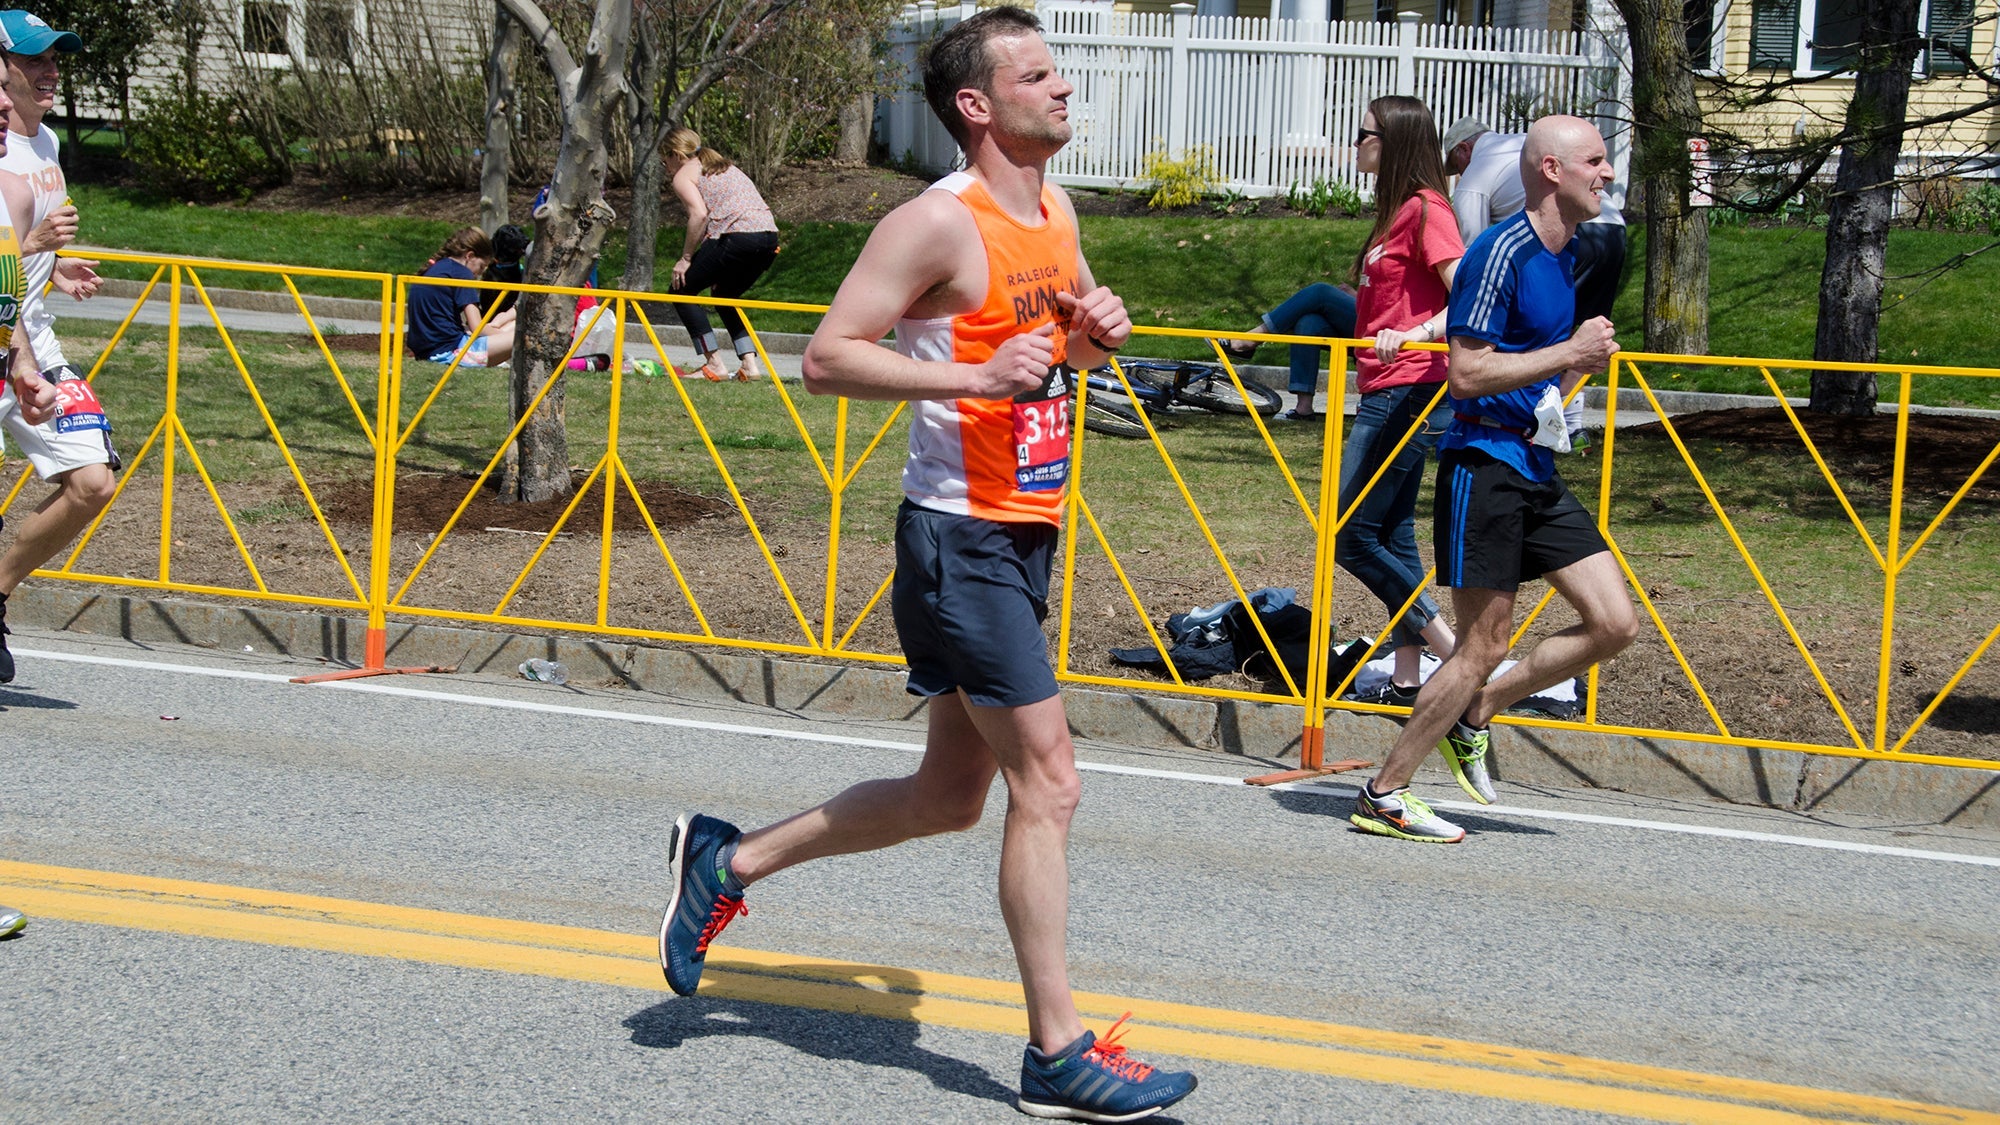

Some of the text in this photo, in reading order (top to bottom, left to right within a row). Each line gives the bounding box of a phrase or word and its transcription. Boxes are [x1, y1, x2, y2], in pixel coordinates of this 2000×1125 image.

[1006, 264, 1060, 287] RALEIGH
[1024, 400, 1068, 445] 315
[1019, 446, 1028, 463] 4
